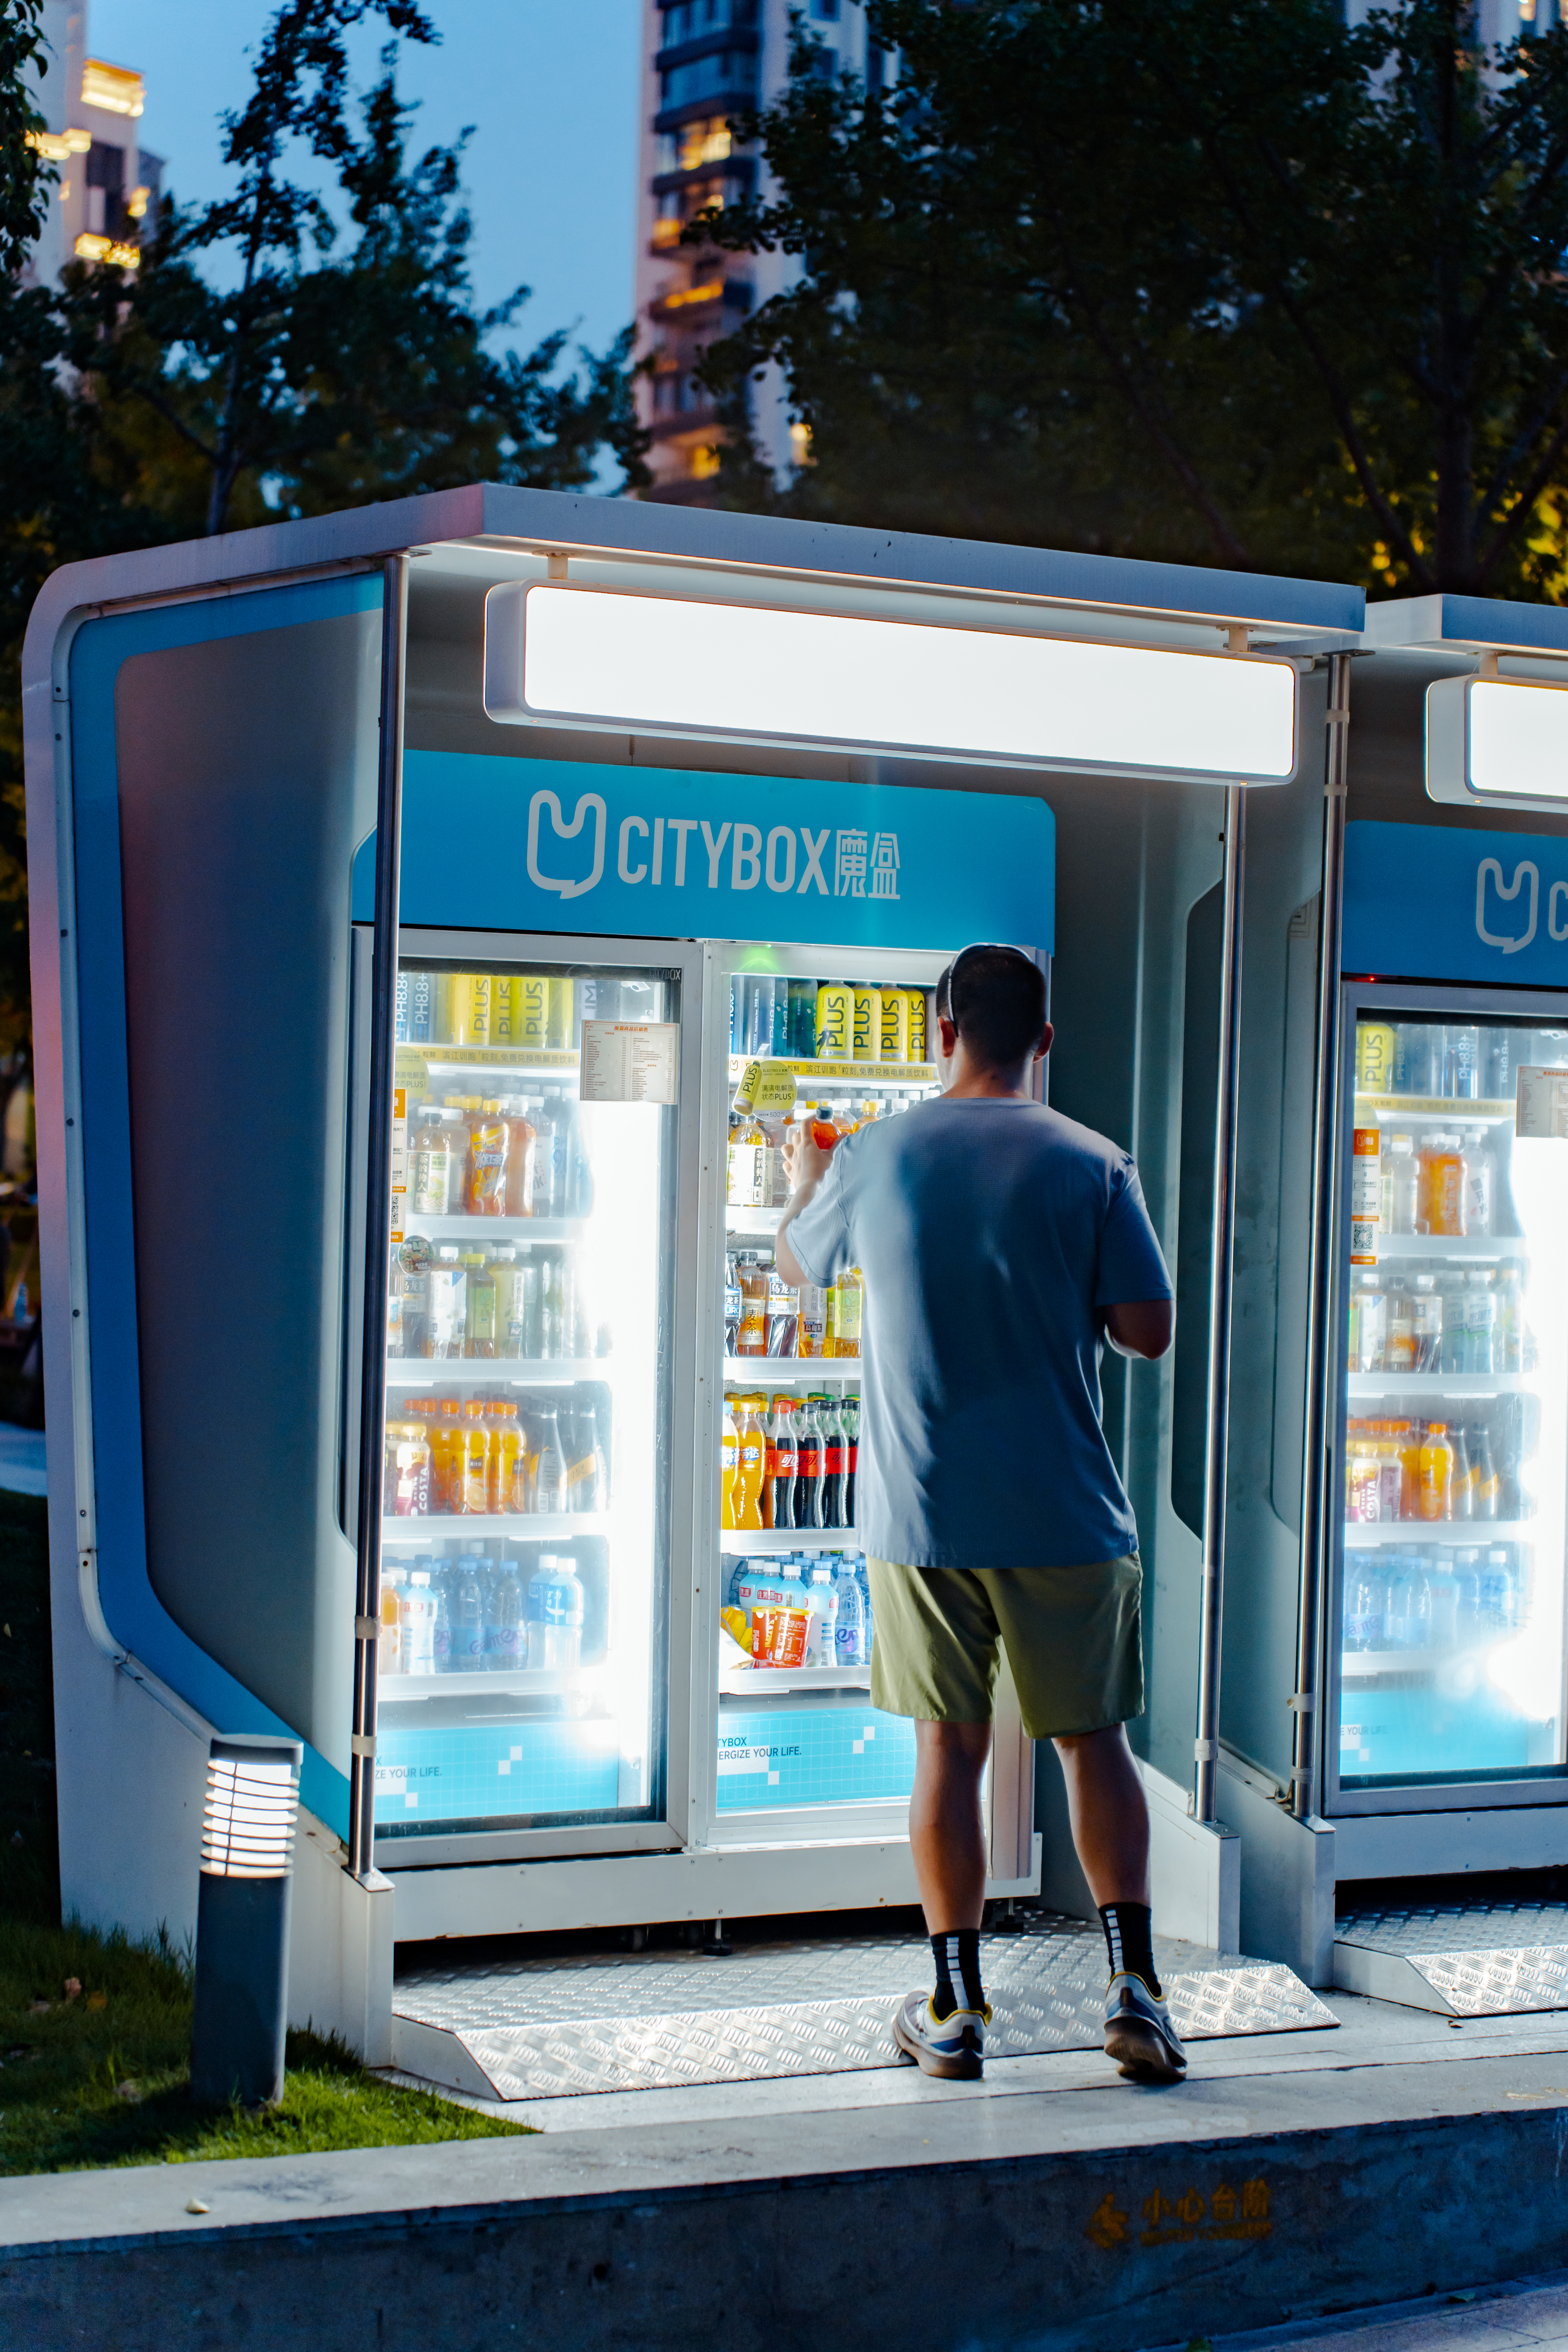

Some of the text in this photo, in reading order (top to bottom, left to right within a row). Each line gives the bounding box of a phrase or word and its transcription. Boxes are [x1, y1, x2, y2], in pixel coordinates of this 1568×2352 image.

[617, 815, 902, 900] CITYBOX 魔盒
[649, 968, 680, 980] CITYBOX
[415, 973, 429, 1024] pH8.8+
[474, 978, 489, 1031] PLUS
[498, 982, 511, 1035] PLUS
[526, 981, 543, 1035] PLUS
[826, 996, 845, 1047] PLUS
[854, 998, 870, 1048] PLUS
[882, 999, 900, 1050] PLUS
[911, 1000, 924, 1049] PLUS
[742, 1067, 757, 1093] PLUS
[1365, 1034, 1383, 1082] PLUS
[417, 1154, 428, 1191] 茶的传人
[475, 1152, 504, 1170] 冰红茶
[746, 1309, 757, 1335] 麦茶
[743, 1447, 760, 1459] 芬达
[419, 1467, 428, 1511] COSTA
[1366, 1480, 1376, 1519] COSTA
[753, 1747, 779, 1758] YOUR
[781, 1746, 802, 1756] LIFE.
[1347, 1726, 1369, 1735] YOUR
[389, 1768, 417, 1778] YOUR
[420, 1766, 442, 1777] LIFE.
